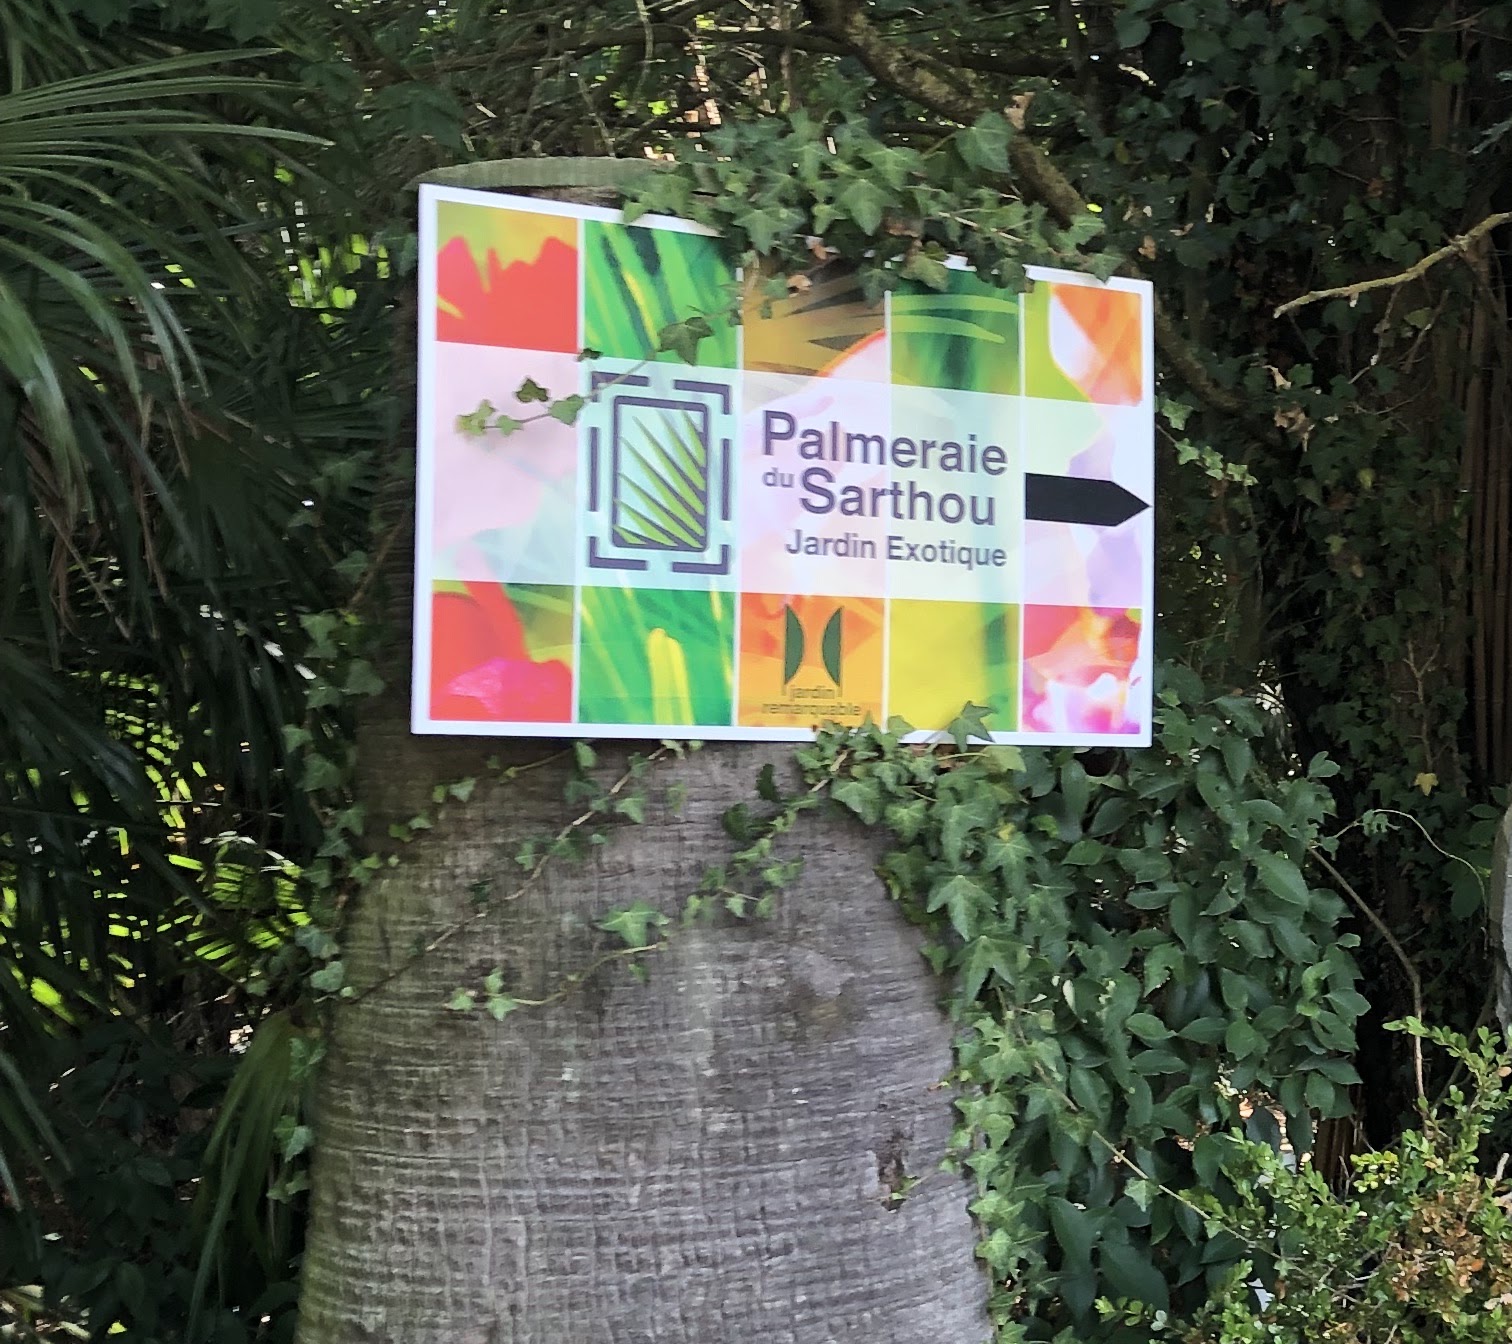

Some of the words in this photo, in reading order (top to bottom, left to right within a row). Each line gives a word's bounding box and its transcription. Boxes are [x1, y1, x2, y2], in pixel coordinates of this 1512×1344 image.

[762, 409, 1008, 476] Palmeraie
[762, 467, 794, 488] du
[799, 466, 996, 526] Sarthou
[785, 529, 877, 559] Jardin
[885, 535, 1008, 570] Exotique
[761, 702, 861, 718] remarquable
[789, 684, 835, 701] jardin
